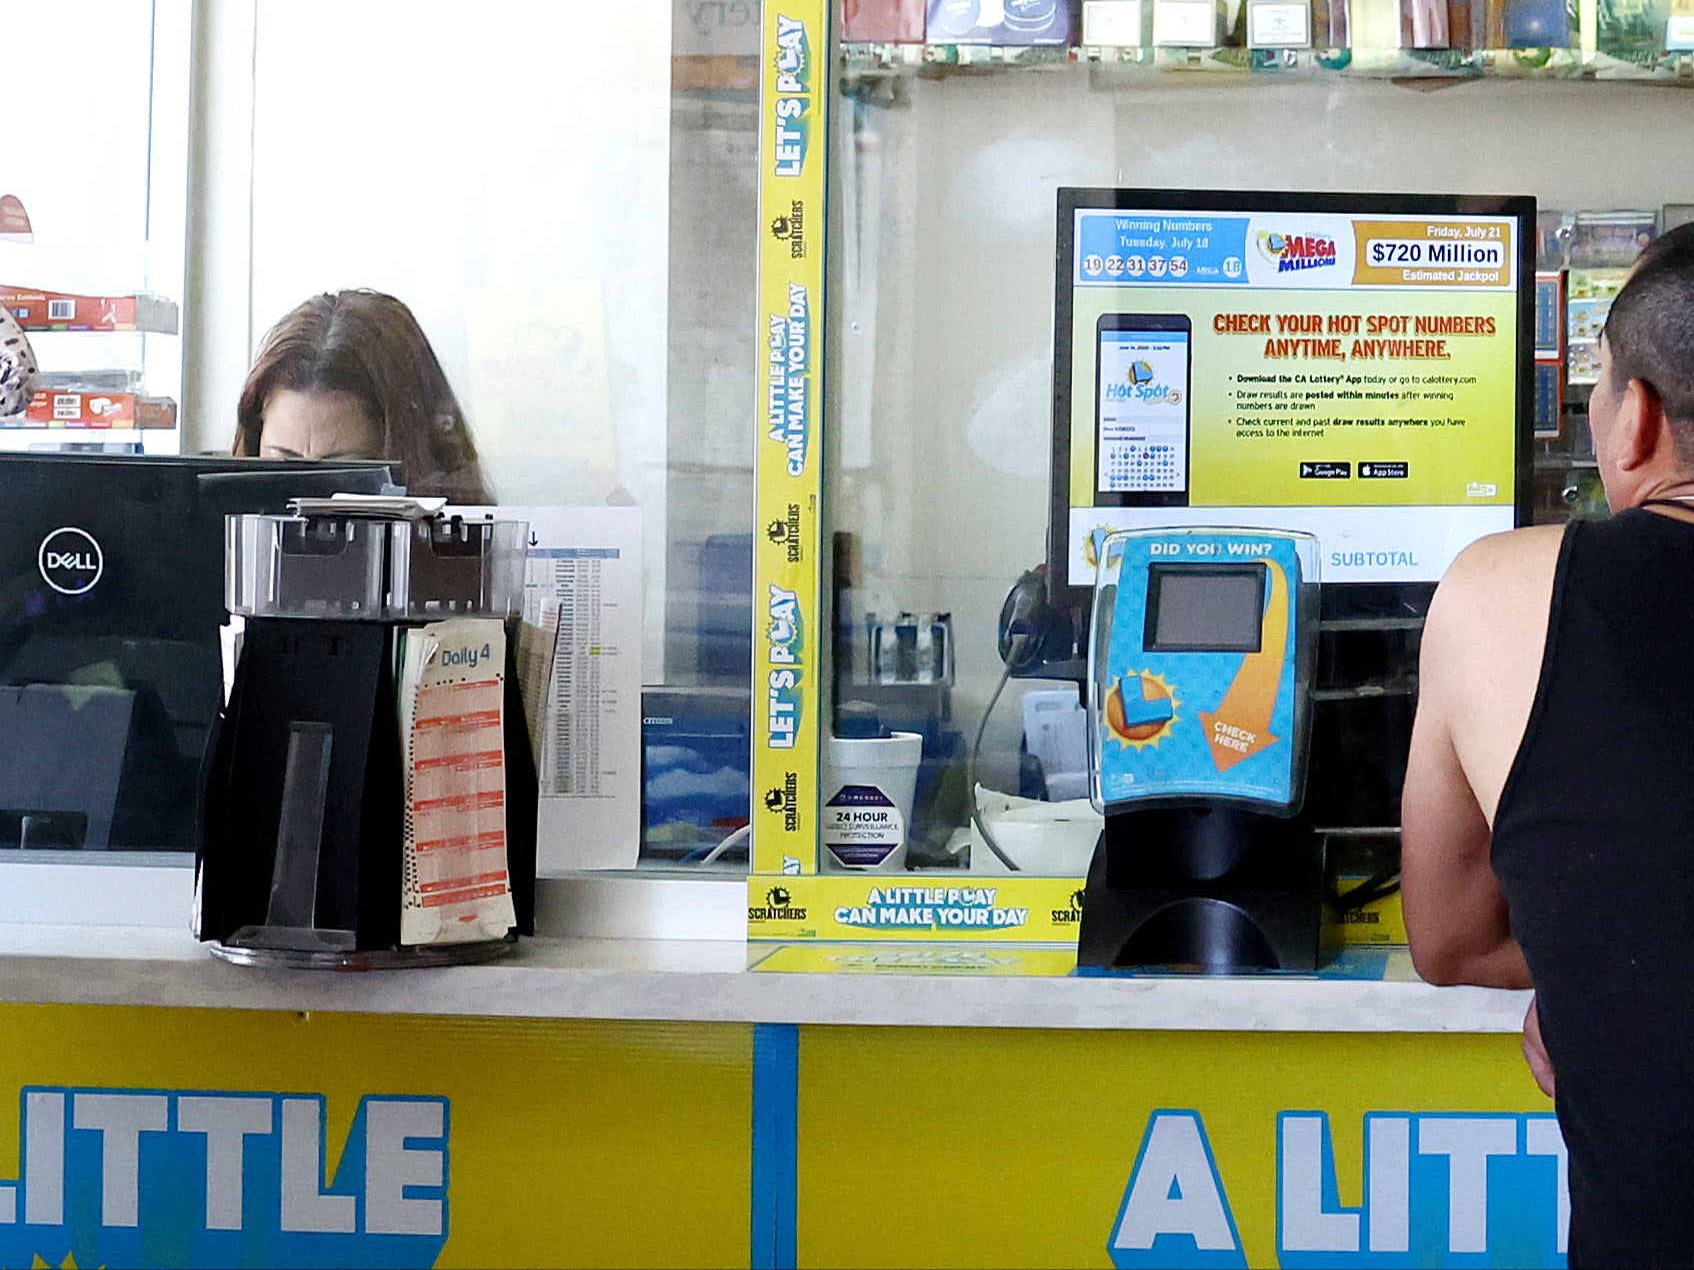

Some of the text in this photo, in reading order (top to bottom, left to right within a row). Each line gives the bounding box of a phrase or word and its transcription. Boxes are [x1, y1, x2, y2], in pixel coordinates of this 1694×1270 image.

[774, 97, 803, 176] LET'S
[1115, 219, 1213, 233] Winning Numbers
[1427, 225, 1502, 240] Friday, July 21
[1170, 237, 1193, 250] July
[1284, 234, 1337, 259] MEGA
[1372, 242, 1499, 263] $720 Million
[1085, 258, 1101, 271] 19
[1107, 258, 1125, 271] 22
[1127, 259, 1145, 272] 31
[1149, 259, 1166, 272] 37
[1170, 259, 1187, 272] 54
[1402, 270, 1500, 284] Estimated Jackpot
[1213, 313, 1497, 337] CHECK YOUR HOT SPOT NUMBERS
[1264, 338, 1452, 361] ANYTIME, ANYWHERE.
[1236, 374, 1277, 384] Download
[1279, 374, 1293, 384] the
[1294, 375, 1307, 384] CA
[1346, 375, 1362, 385] App
[1364, 375, 1387, 386] today
[1388, 377, 1398, 385] or
[1399, 376, 1409, 386] go
[1411, 375, 1420, 385] to
[1422, 375, 1477, 386] calottery.com
[1105, 382, 1132, 398] Hot
[1150, 542, 1273, 556] DID YOU WIN?
[46, 551, 97, 570] DELL
[1331, 551, 1419, 568] SUBTOTAL
[441, 643, 491, 668] Daily 4
[1213, 721, 1257, 745] CHECK
[1213, 735, 1250, 753] HERE
[836, 812, 888, 823] 24 HOUR
[0, 1089, 449, 1236] ITTLE
[1109, 1110, 1237, 1253] A
